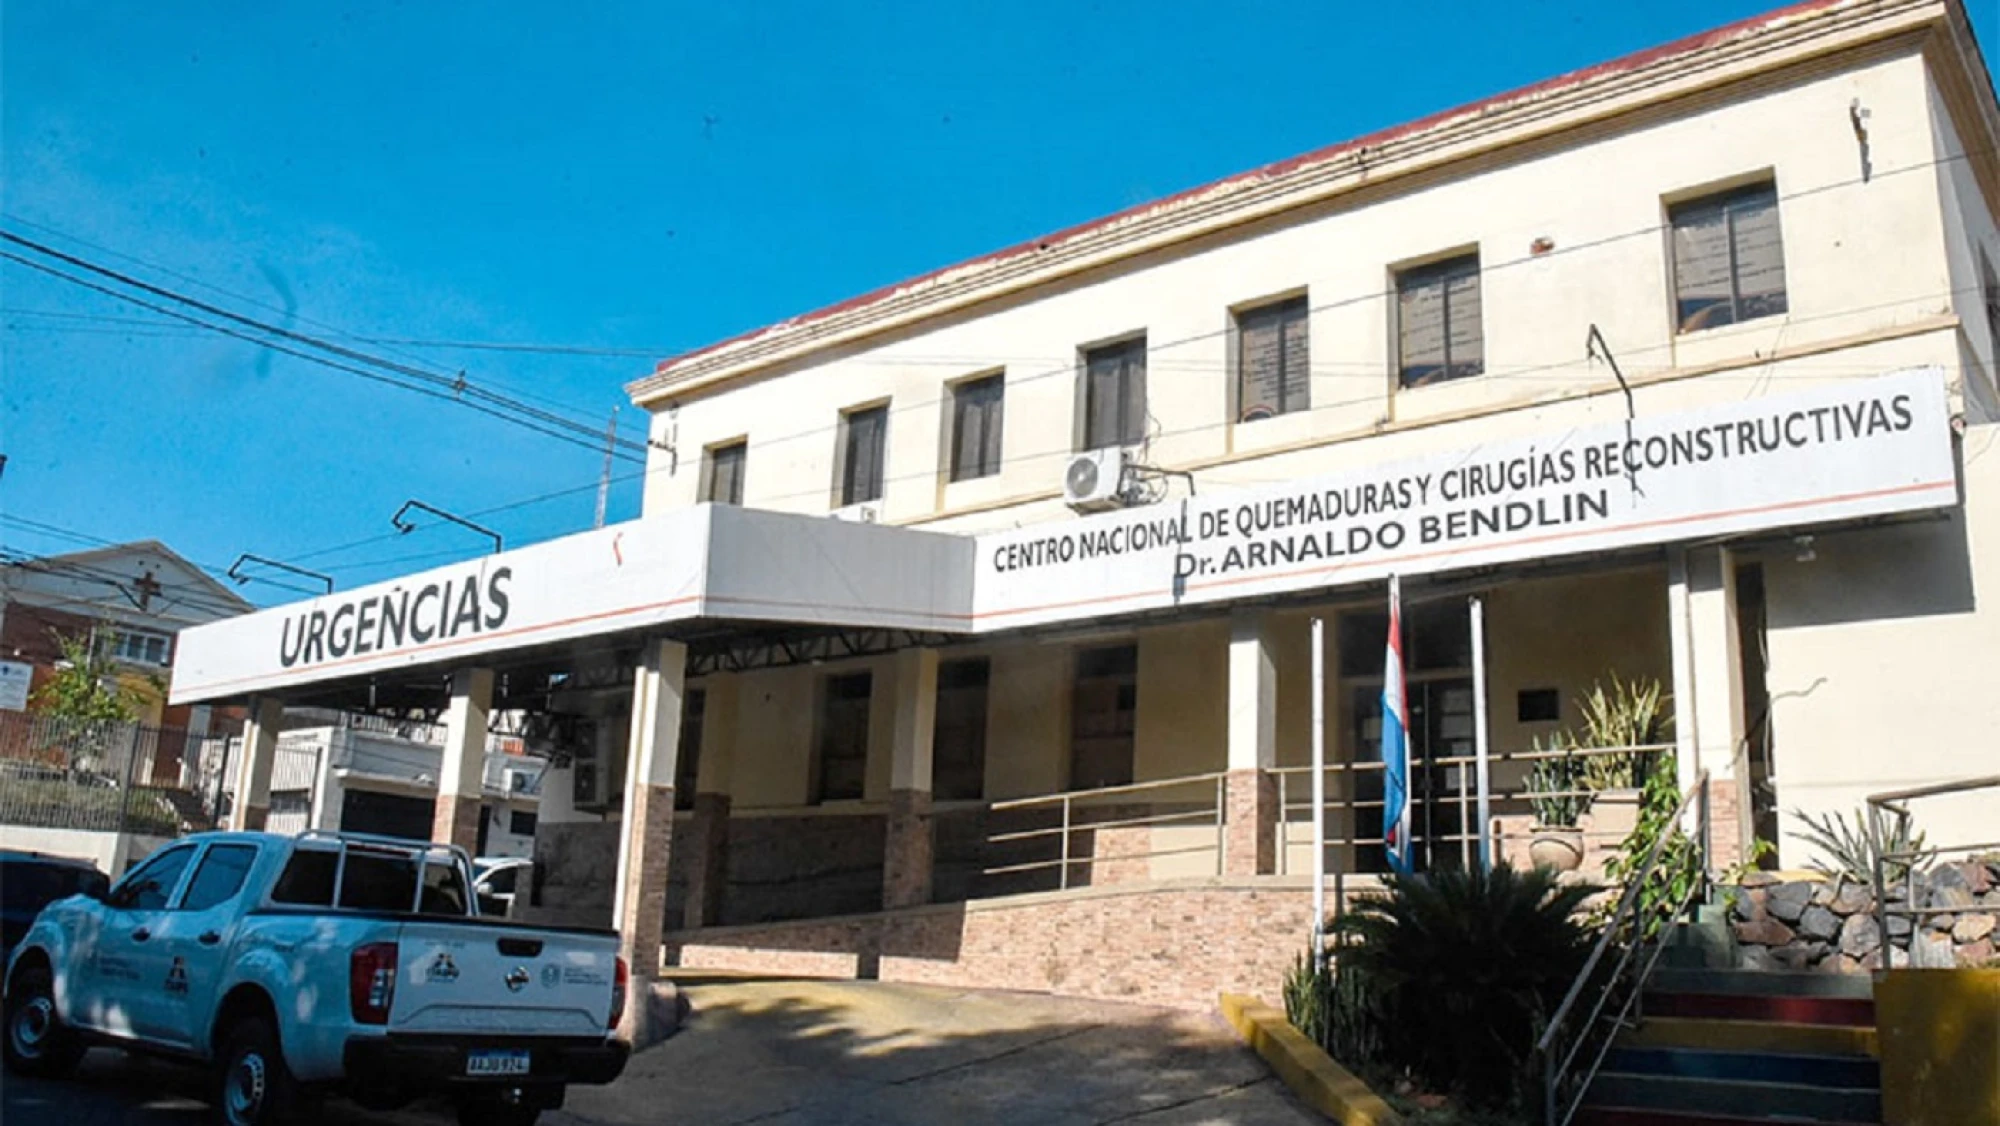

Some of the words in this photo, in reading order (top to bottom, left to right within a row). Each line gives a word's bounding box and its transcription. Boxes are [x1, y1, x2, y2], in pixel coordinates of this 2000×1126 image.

[993, 534, 1075, 573] CENTRO
[1079, 514, 1193, 560] NACIONAL
[1200, 508, 1230, 540] DE
[1236, 477, 1412, 533] QUEMADURAS
[1416, 474, 1432, 504] Y
[1440, 446, 1577, 500] CIRUGÍAS
[1585, 395, 1913, 481] RECONSTRUCTIVAS
[1420, 489, 1608, 544] BENDLIN
[280, 566, 512, 667] URGENCIAS
